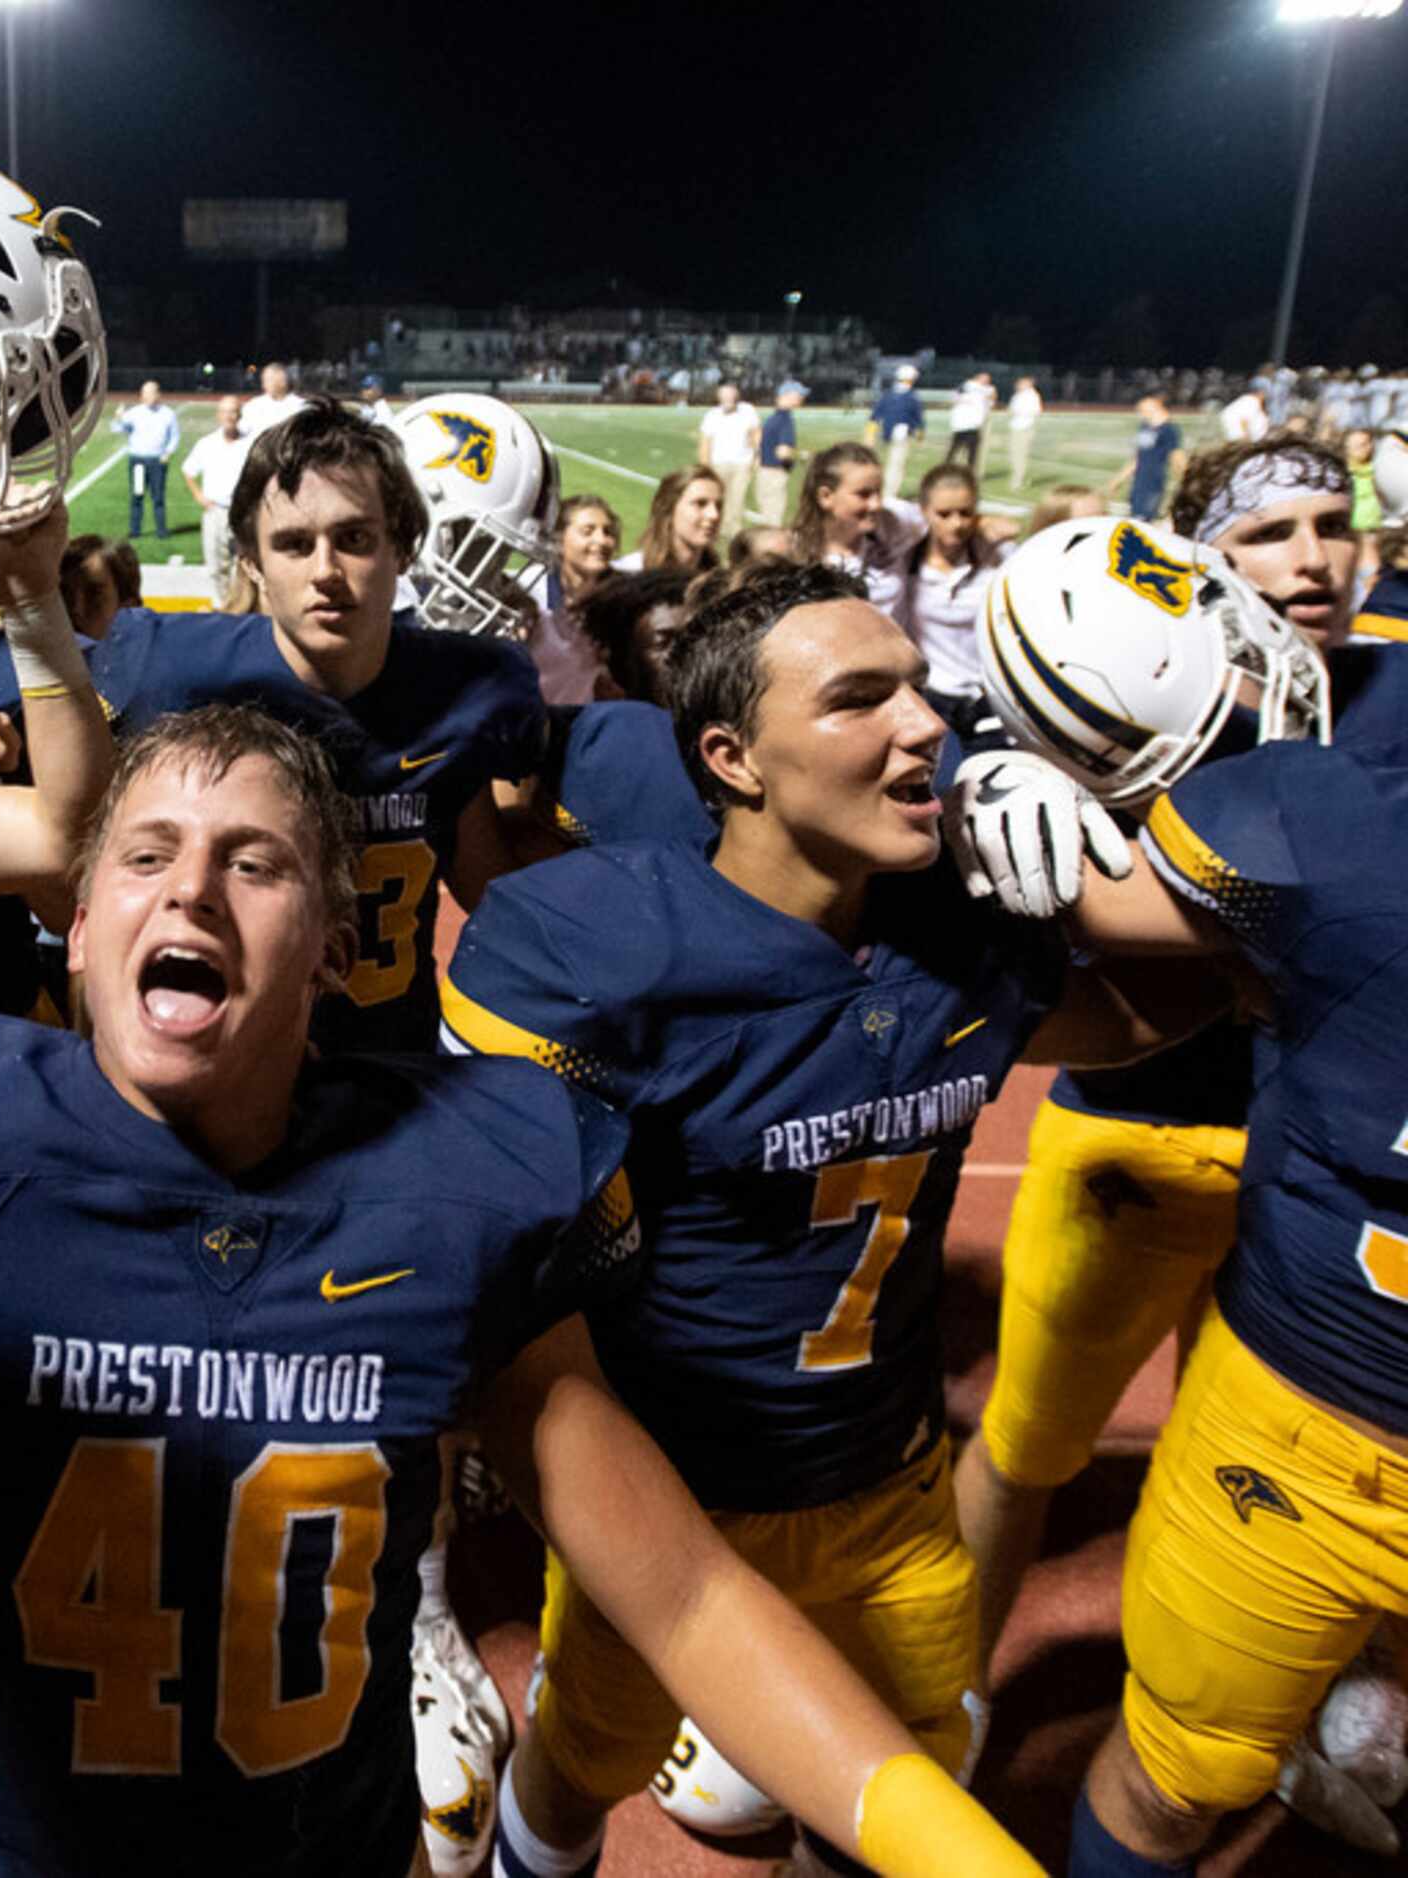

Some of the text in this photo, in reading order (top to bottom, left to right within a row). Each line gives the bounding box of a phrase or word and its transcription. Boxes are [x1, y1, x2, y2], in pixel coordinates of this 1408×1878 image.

[762, 1075, 988, 1172] PRESTONWOOD
[794, 1149, 938, 1373] 7
[26, 1334, 384, 1422] PRESTONWOOD
[12, 1436, 393, 1778] 40
